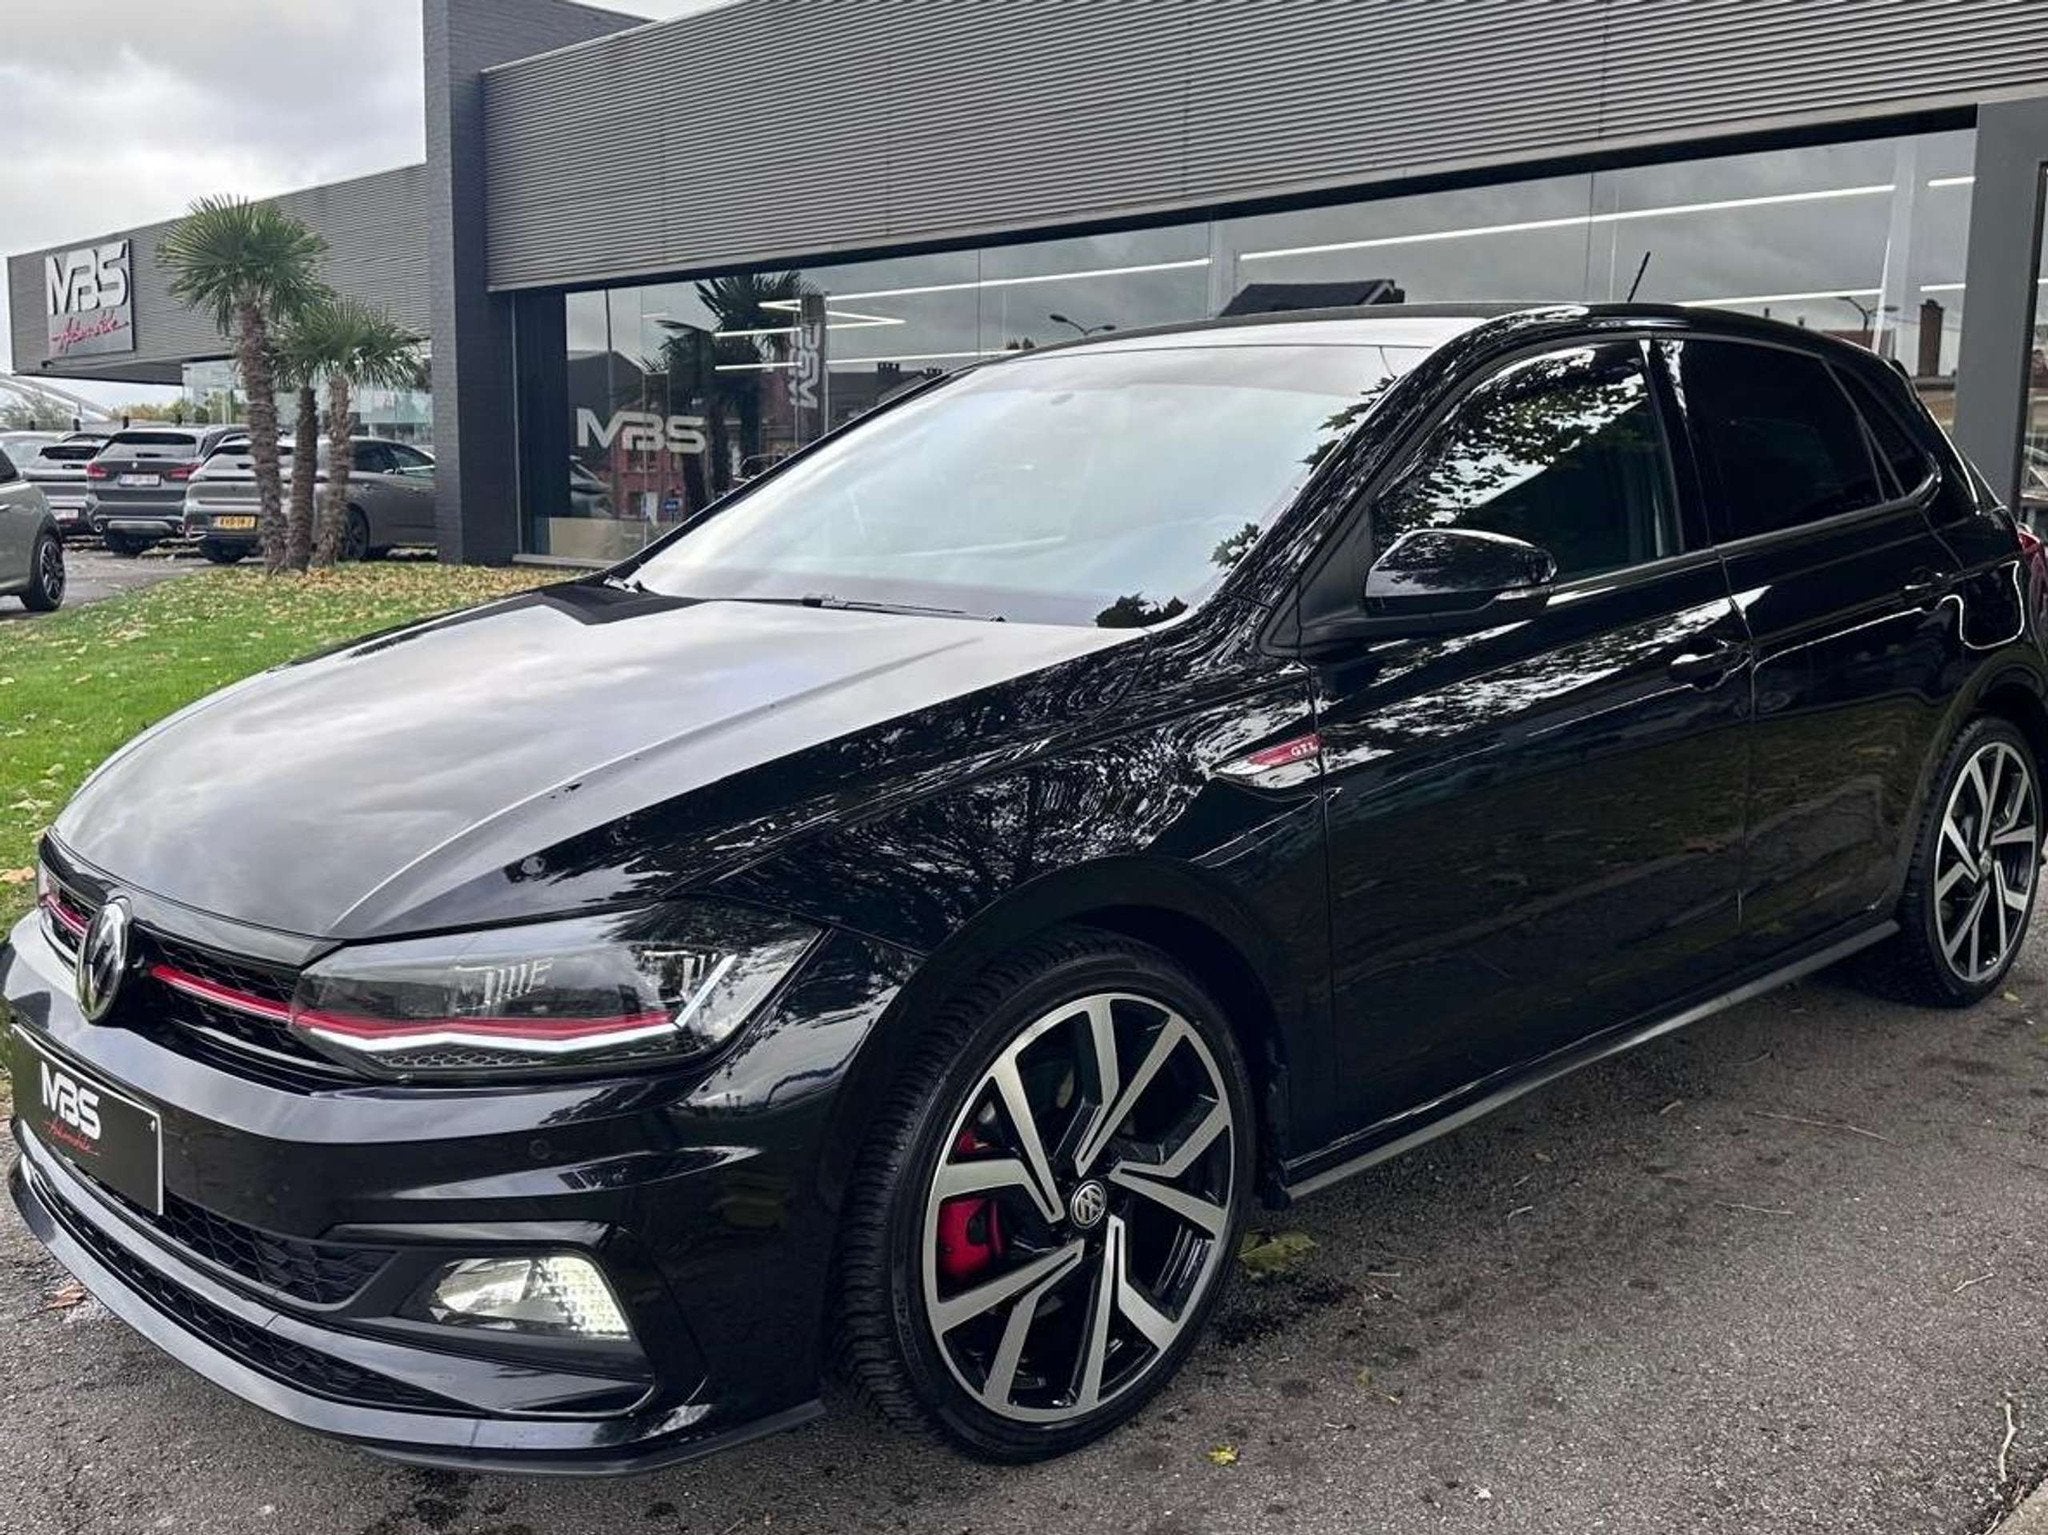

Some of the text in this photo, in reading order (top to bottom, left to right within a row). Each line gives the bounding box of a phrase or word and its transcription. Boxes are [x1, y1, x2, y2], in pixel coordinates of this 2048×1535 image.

[45, 241, 128, 316] MBS
[576, 407, 706, 454] MBS
[41, 1060, 101, 1140] MBS
